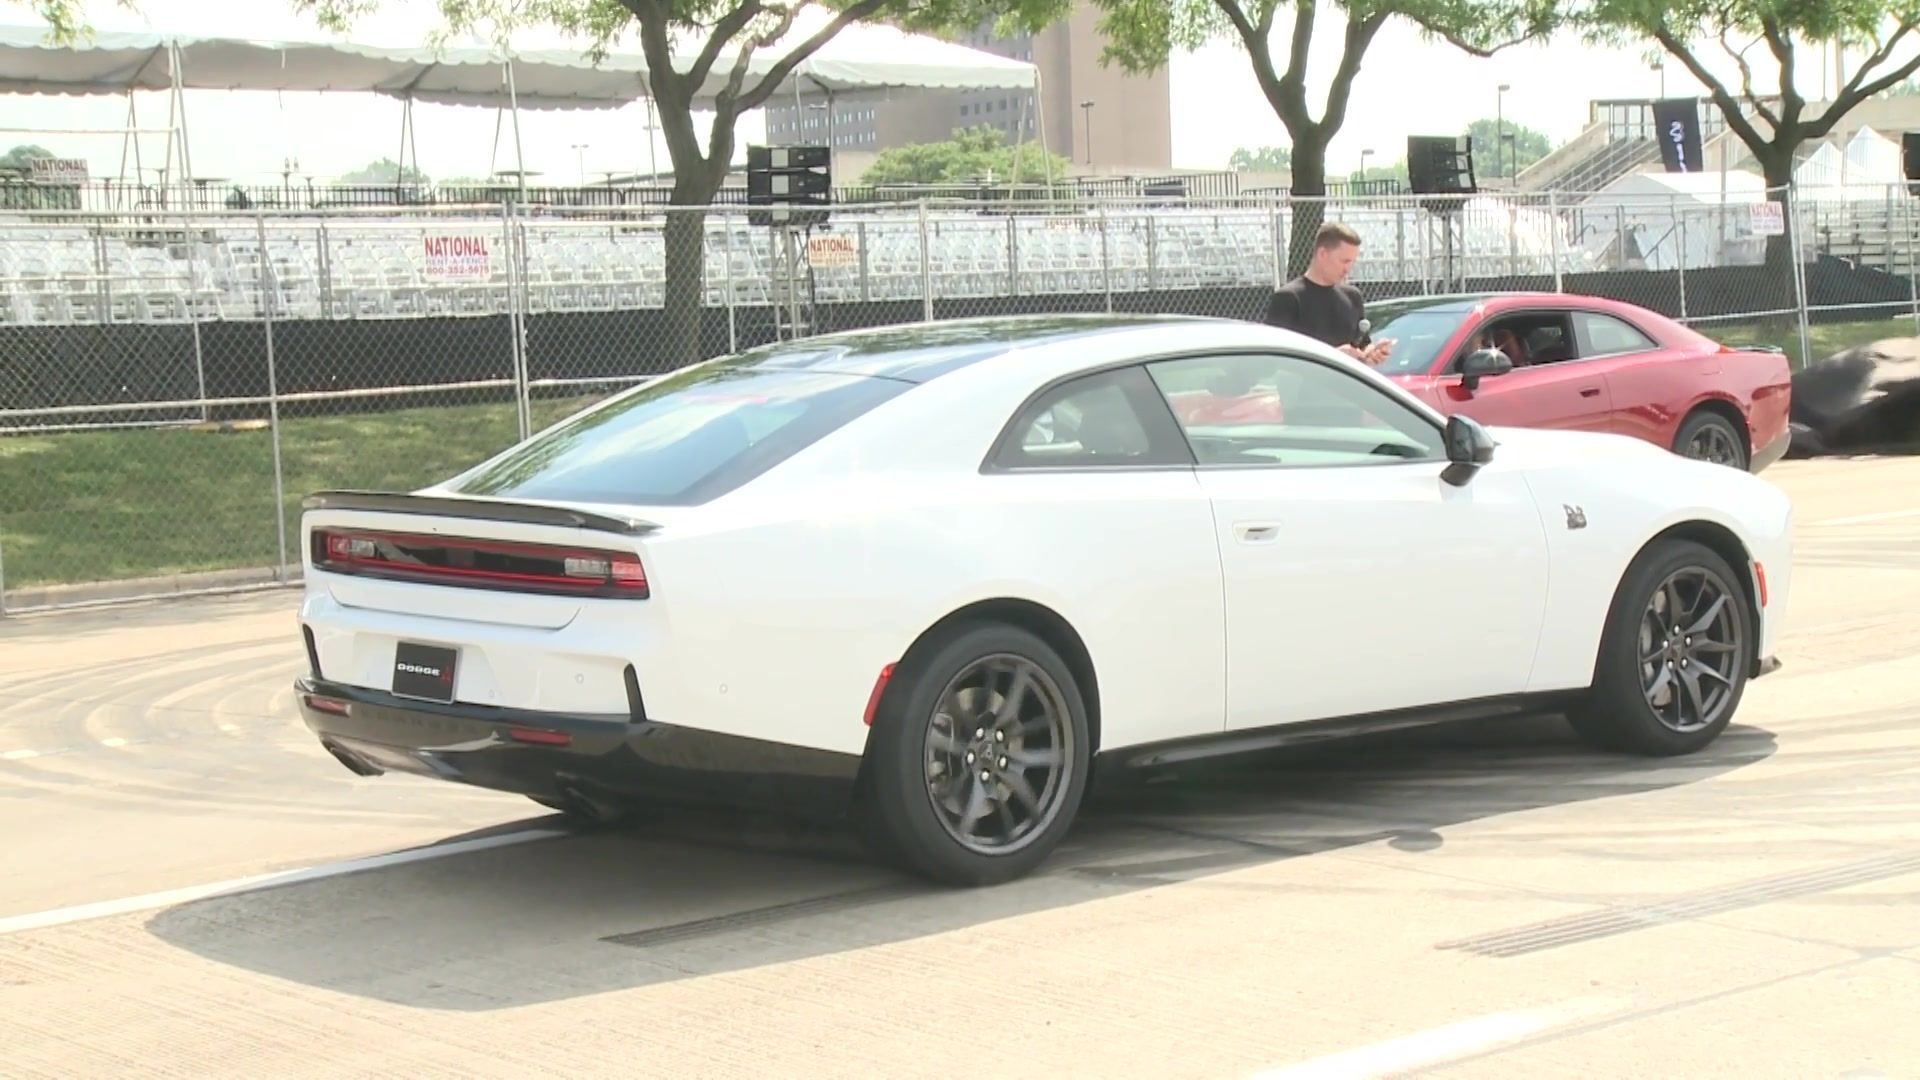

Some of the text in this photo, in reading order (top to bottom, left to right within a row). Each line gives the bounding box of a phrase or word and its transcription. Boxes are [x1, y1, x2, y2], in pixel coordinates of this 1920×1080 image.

[32, 159, 88, 171] NATIONAL
[424, 236, 488, 256] NATIONAL
[810, 239, 853, 252] NATIONAL
[397, 663, 440, 677] DODGE
